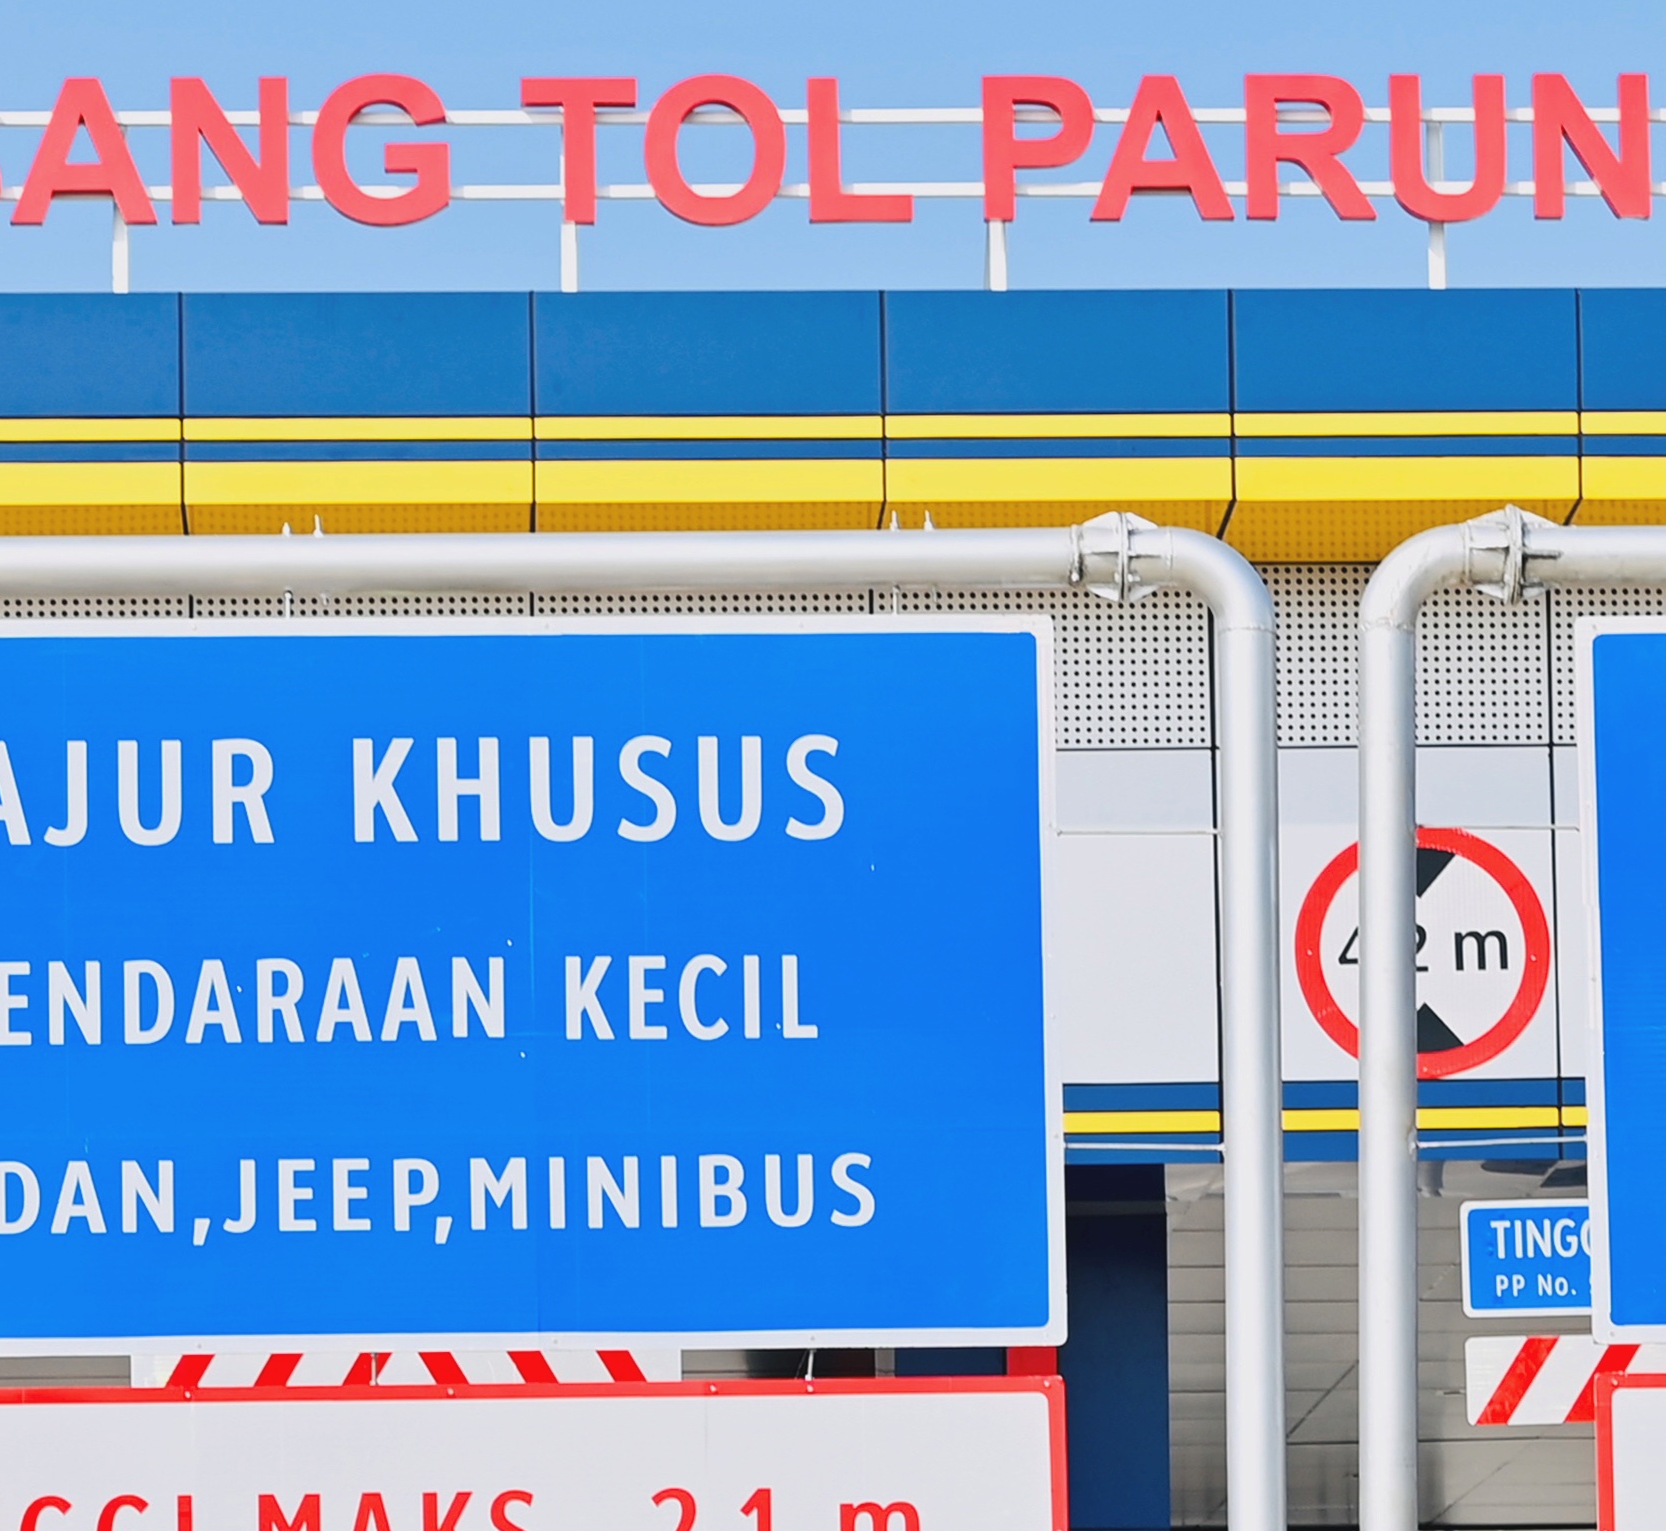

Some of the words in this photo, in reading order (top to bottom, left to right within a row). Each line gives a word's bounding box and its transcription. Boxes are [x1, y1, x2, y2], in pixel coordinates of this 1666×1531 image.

[520, 73, 915, 226] TOL
[353, 734, 844, 843] KHUSUS
[1454, 930, 1509, 971] m
[565, 954, 818, 1041] KECIL
[1490, 1218, 1591, 1259] TING
[1496, 1274, 1525, 1297] PP
[1537, 1274, 1576, 1296] No.
